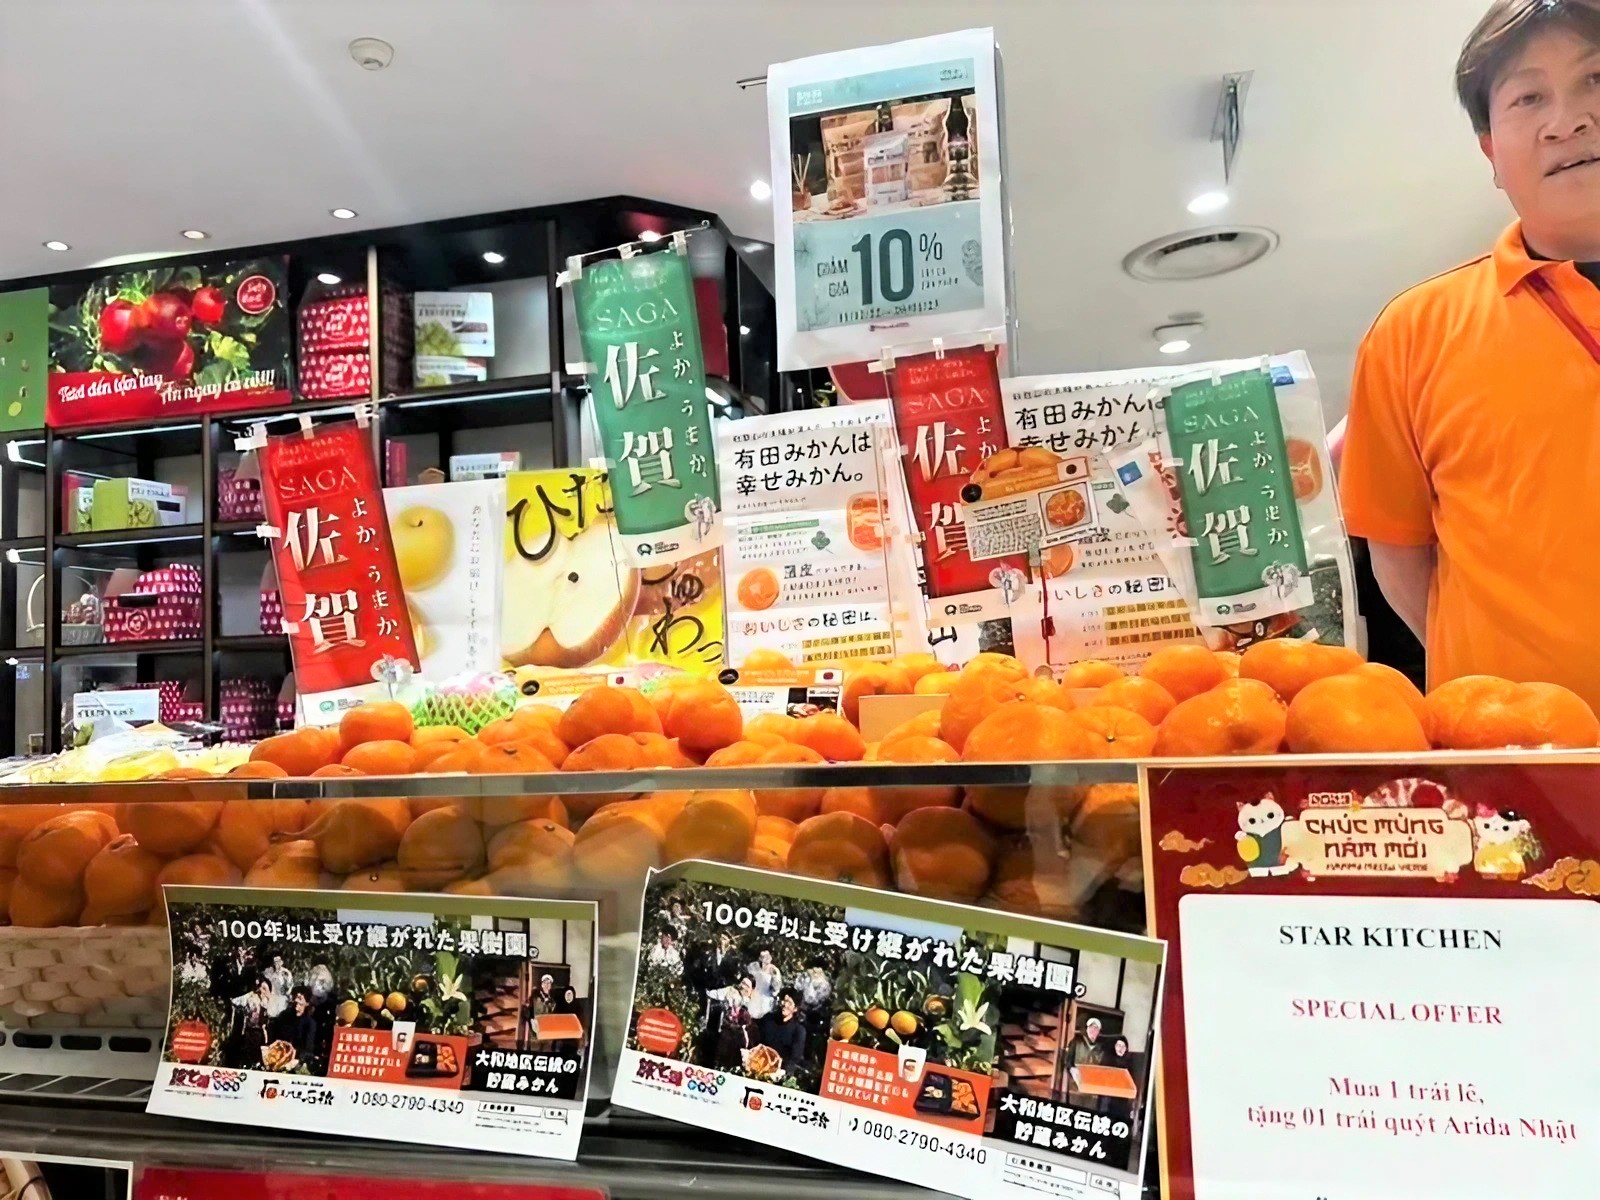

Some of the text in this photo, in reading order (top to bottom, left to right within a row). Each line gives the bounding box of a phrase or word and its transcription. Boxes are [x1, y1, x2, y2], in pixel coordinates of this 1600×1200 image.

[596, 298, 678, 331] SAGA
[603, 342, 681, 497] 佐賀
[734, 432, 872, 469] 有田みかんは
[279, 466, 357, 499] SAGA
[736, 462, 863, 496] 幸せみかん。
[1188, 438, 1259, 567] 佐賀
[282, 507, 367, 655] 佐賀
[1305, 813, 1368, 834] CHÚC
[1280, 925, 1502, 949] STAR KITCHEN
[1292, 999, 1503, 1025] SPECIAL OFFER
[1329, 1077, 1485, 1104] Mua 1 trái lê,
[1248, 1105, 1578, 1144] tặng 01 trái quýt Arida Nhật
[863, 1120, 987, 1165] 080-2790-4340
